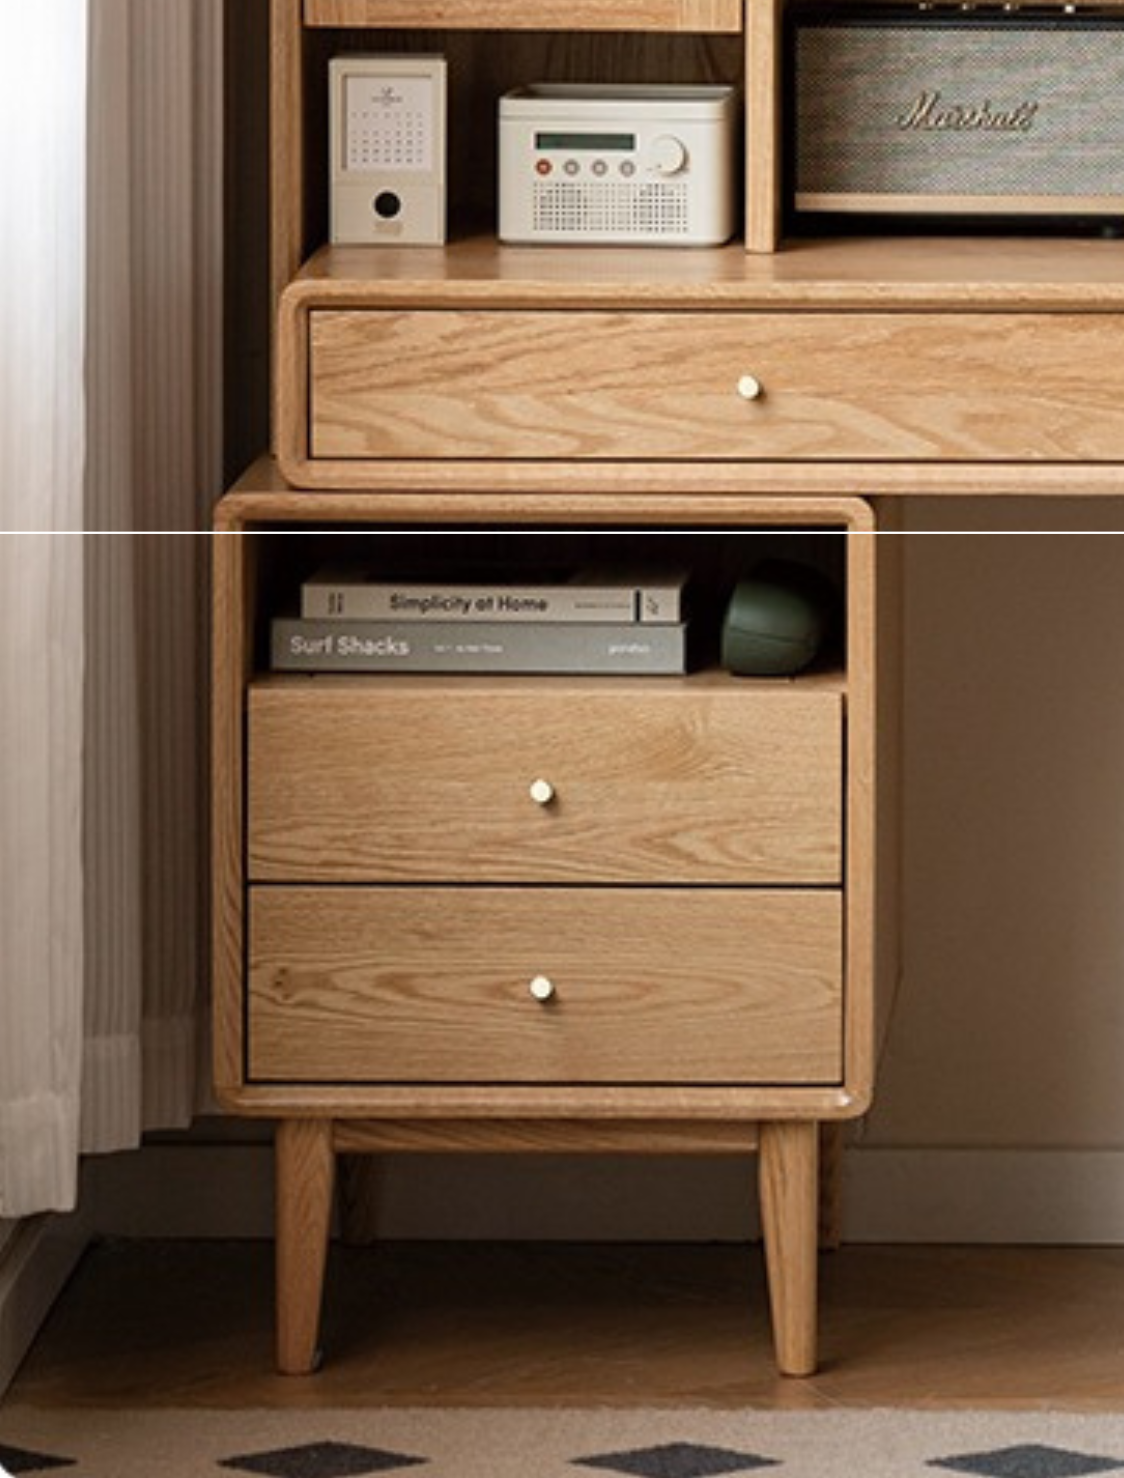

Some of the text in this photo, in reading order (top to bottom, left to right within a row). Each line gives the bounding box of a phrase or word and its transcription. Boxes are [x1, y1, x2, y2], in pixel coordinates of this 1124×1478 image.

[897, 90, 1040, 134] Marshall
[389, 592, 548, 614] Simplicity at Home
[290, 635, 333, 655] Surf
[336, 635, 411, 657] Shacks
